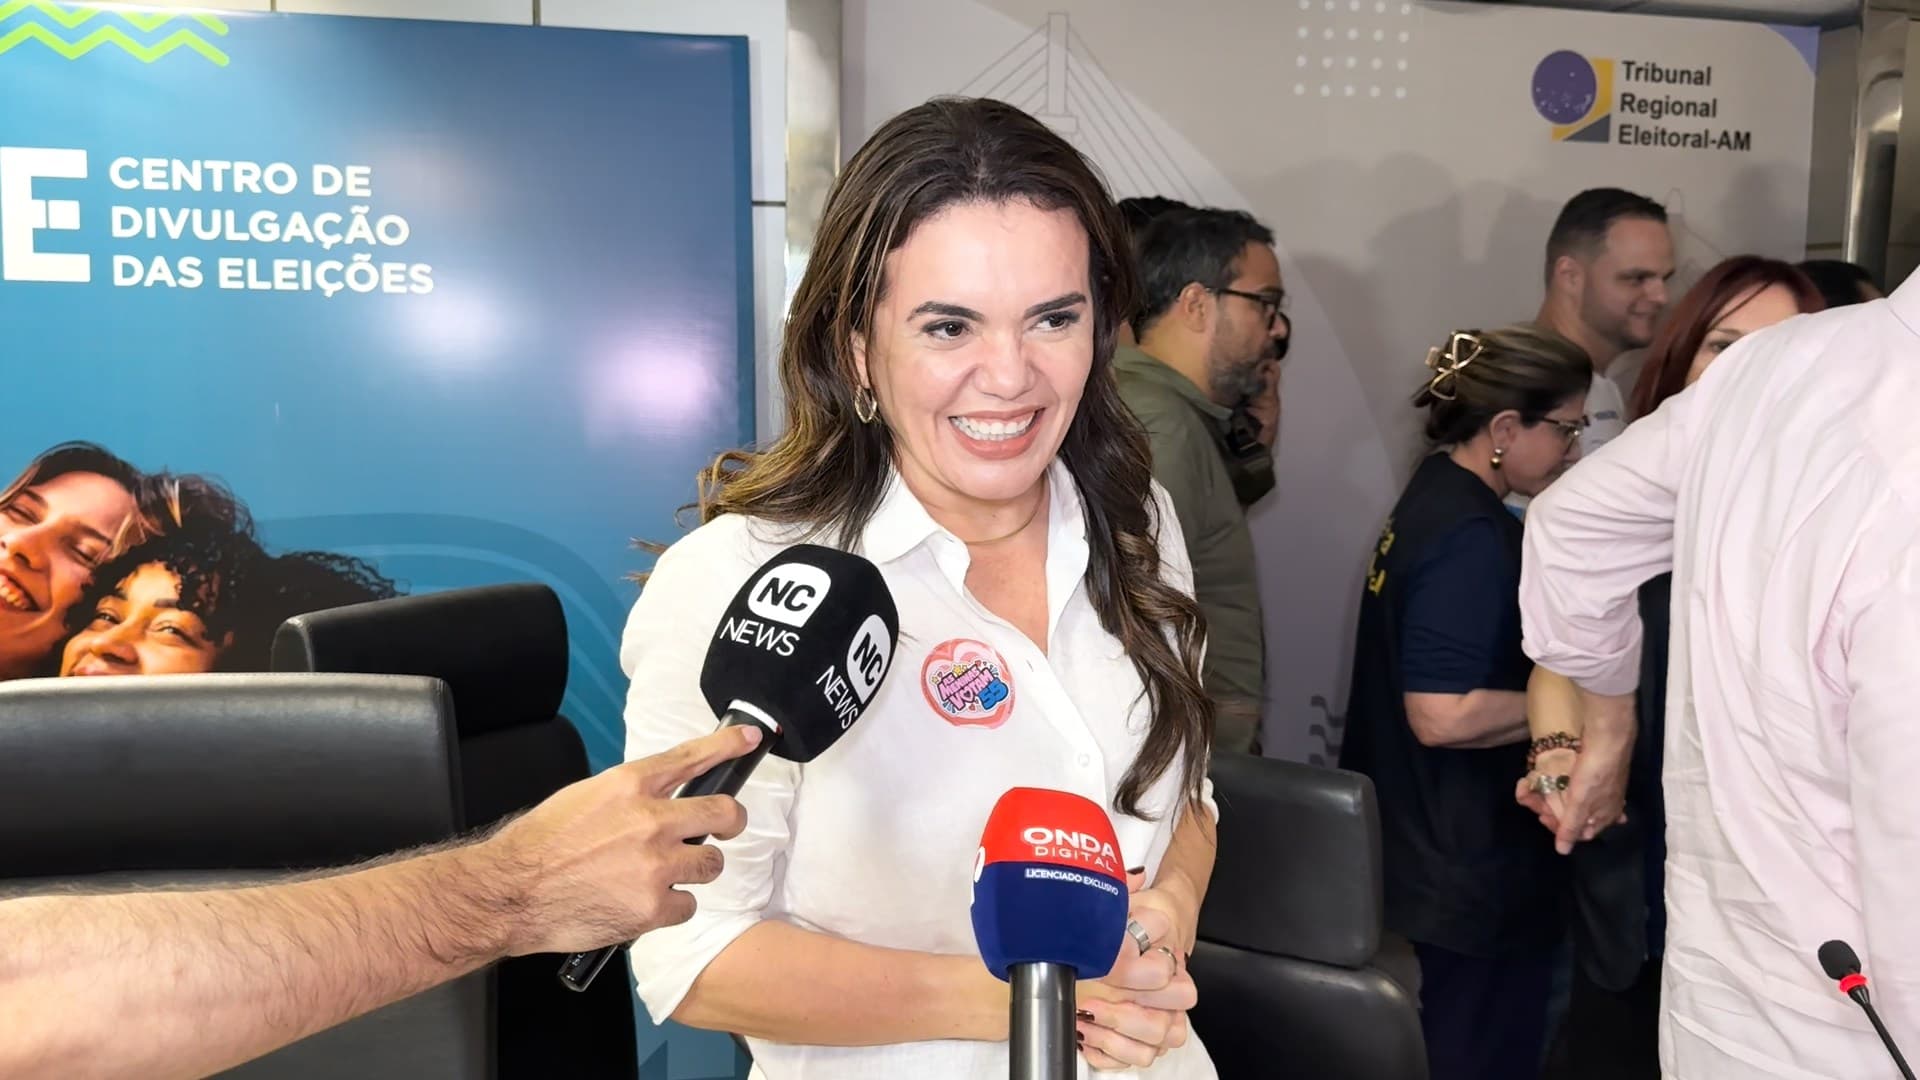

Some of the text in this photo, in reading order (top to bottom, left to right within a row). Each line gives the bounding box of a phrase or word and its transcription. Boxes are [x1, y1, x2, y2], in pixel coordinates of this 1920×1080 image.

[1622, 60, 1712, 86] Tribunal
[1619, 92, 1718, 120] Regional
[1618, 123, 1752, 152] Eleitoral-AM
[109, 156, 372, 198] CENTRO DE
[0, 146, 91, 283] E
[111, 205, 410, 251] DIVULGAÇÃO
[112, 254, 435, 298] DAS ELEIÇÕES
[756, 577, 816, 612] NC
[719, 616, 800, 657] NEWS
[853, 634, 882, 687] NC
[816, 665, 859, 729] NEWS
[979, 677, 1009, 710] 55
[1023, 827, 1118, 864] ONDA
[1035, 846, 1114, 873] DIGITAL
[1025, 867, 1119, 896] LICENCIADO EXCLUSIVO
